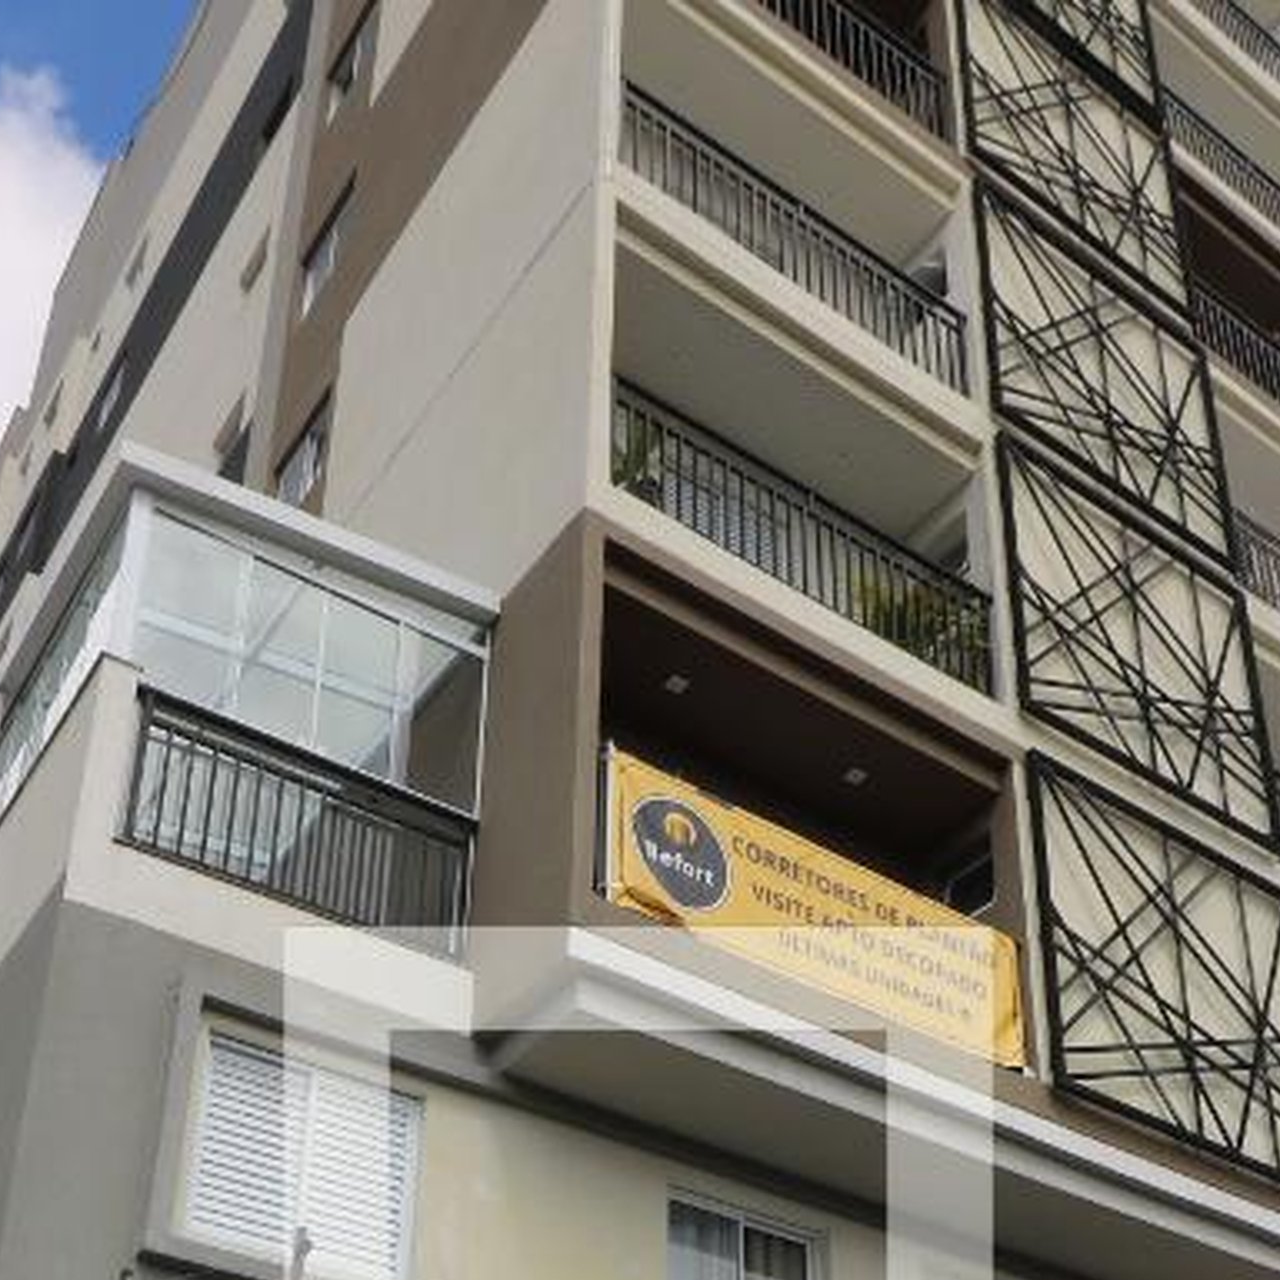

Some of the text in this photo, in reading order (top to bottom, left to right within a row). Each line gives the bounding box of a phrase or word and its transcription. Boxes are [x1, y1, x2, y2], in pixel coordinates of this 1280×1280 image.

[732, 836, 870, 912] CORRETORES
[875, 902, 900, 927] DE
[752, 884, 815, 925] VISITE
